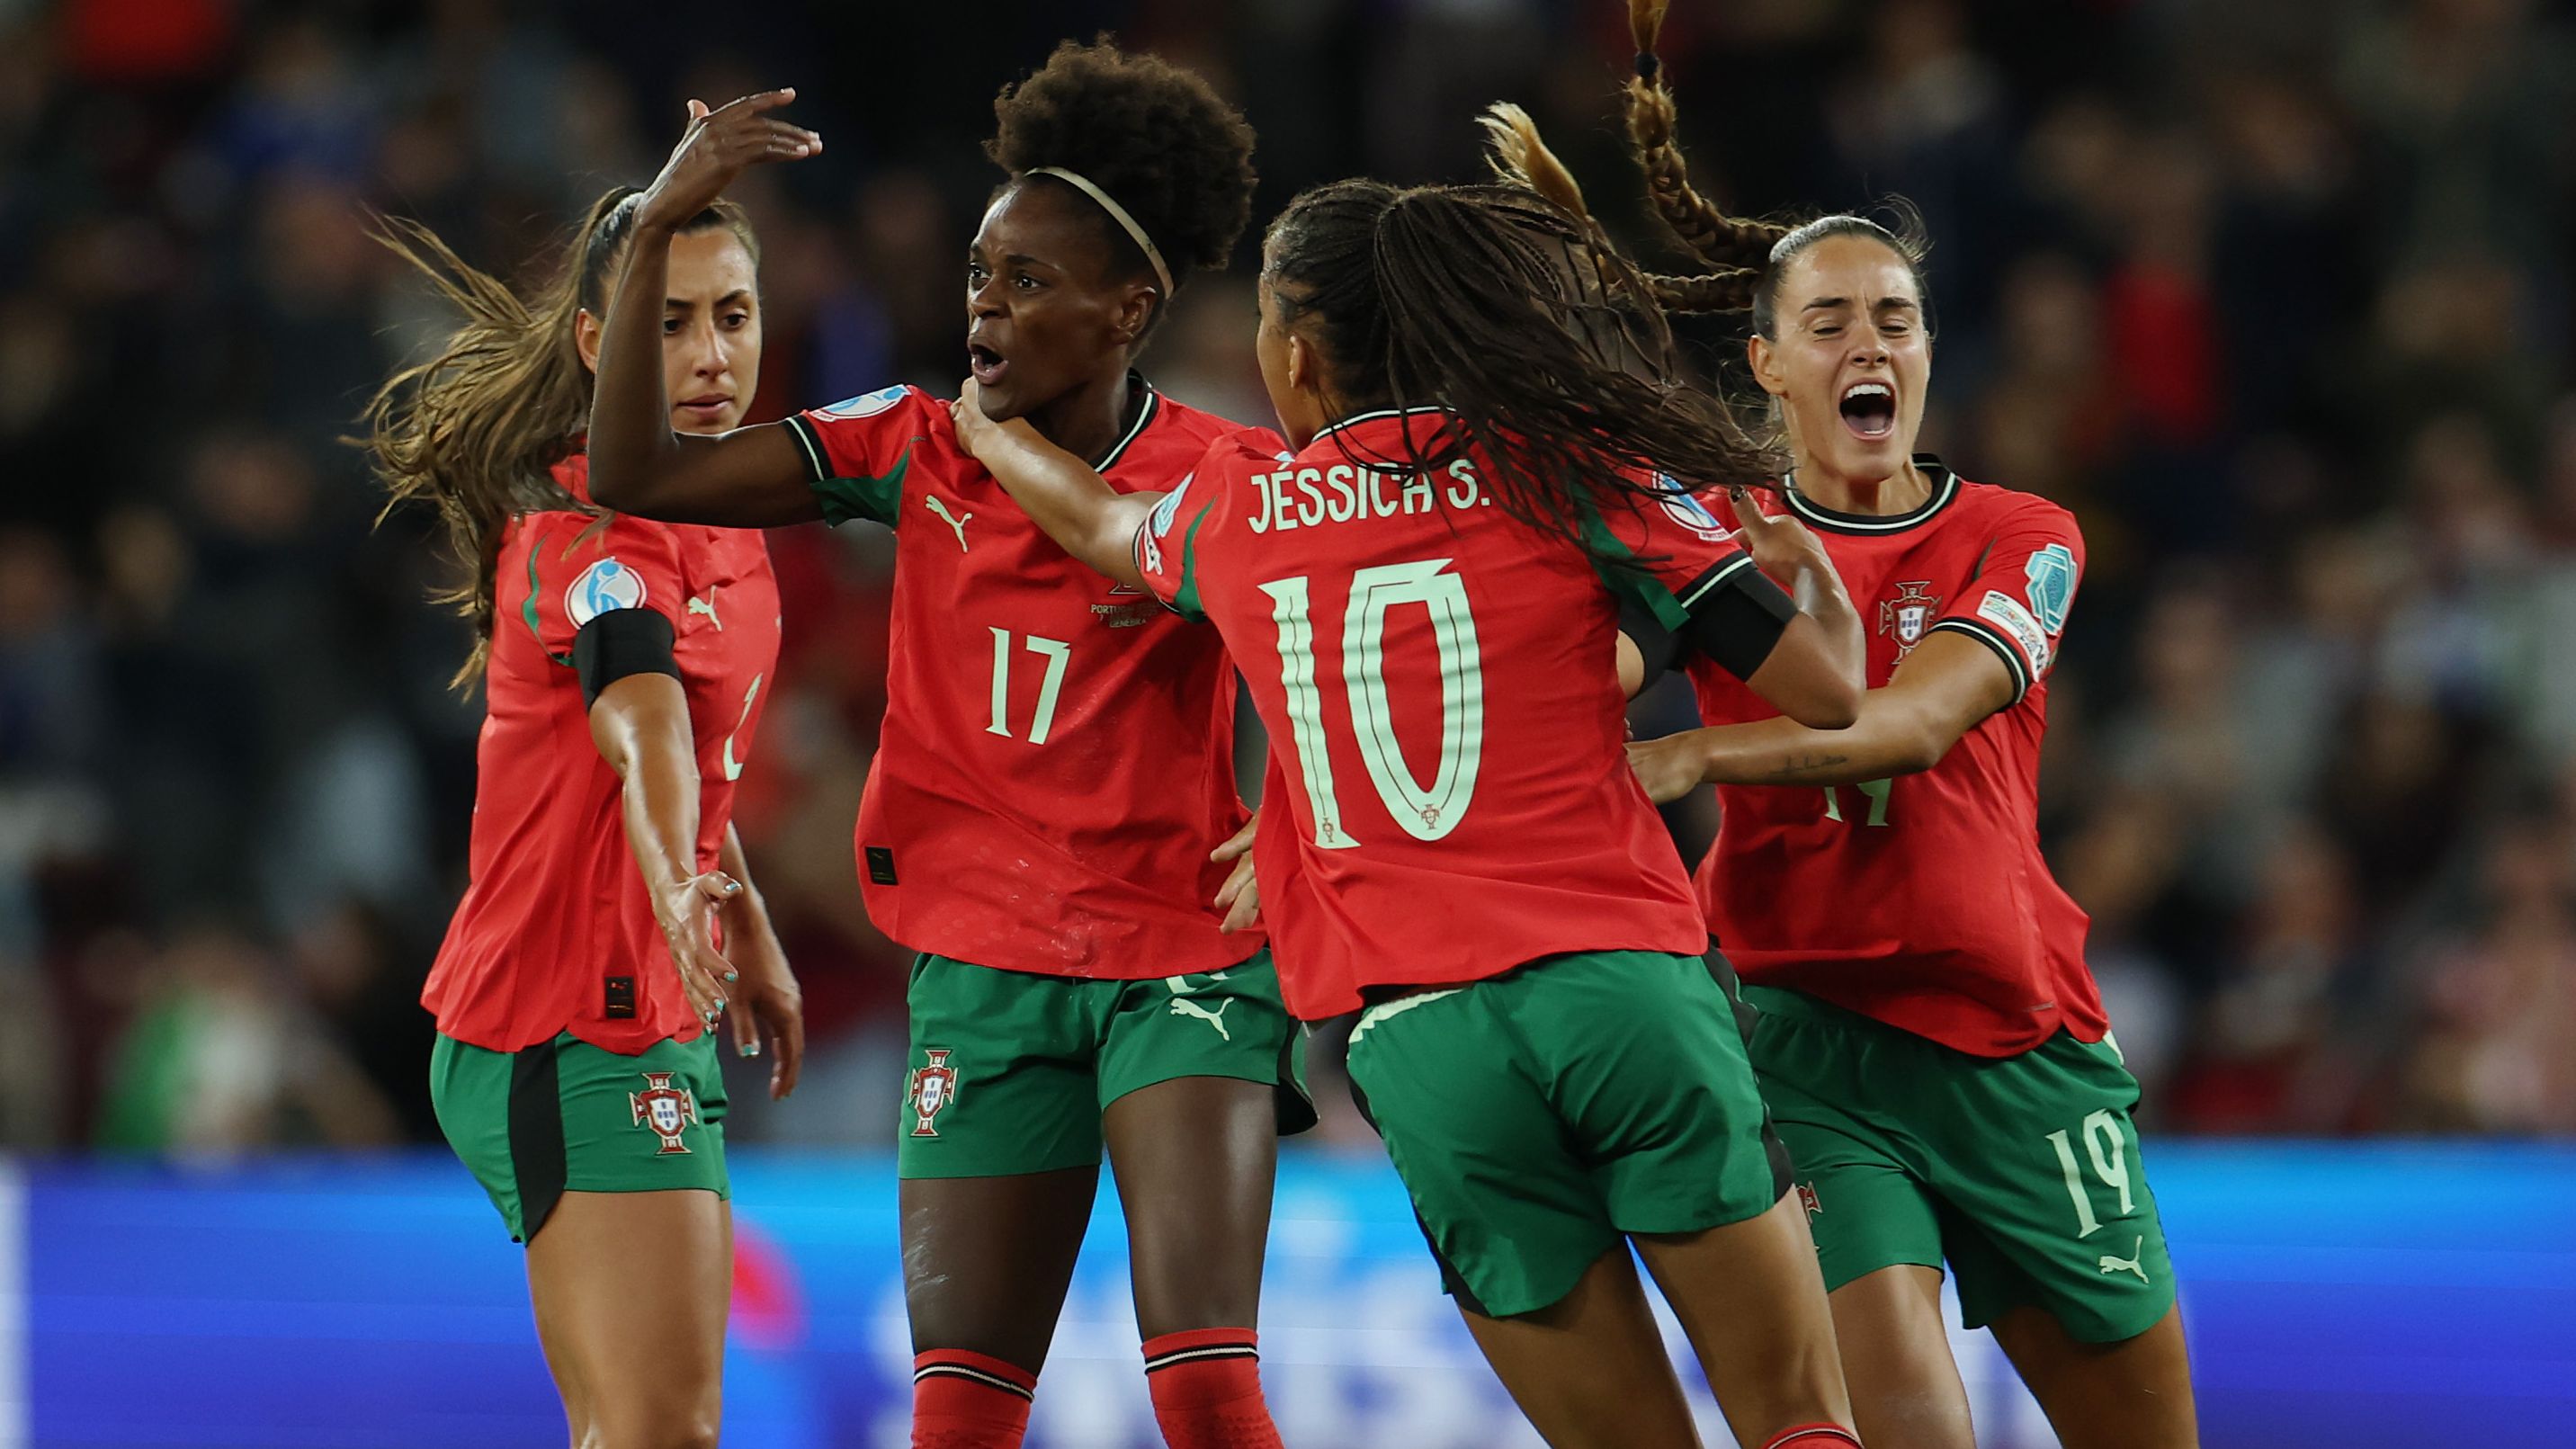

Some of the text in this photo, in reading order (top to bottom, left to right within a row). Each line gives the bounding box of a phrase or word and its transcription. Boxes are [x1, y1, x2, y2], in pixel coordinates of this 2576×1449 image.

[1248, 459, 1489, 533] JÉSSICA S.
[985, 626, 1070, 745] 17
[1257, 558, 1483, 848] 10
[2044, 1108, 2136, 1239] 19
